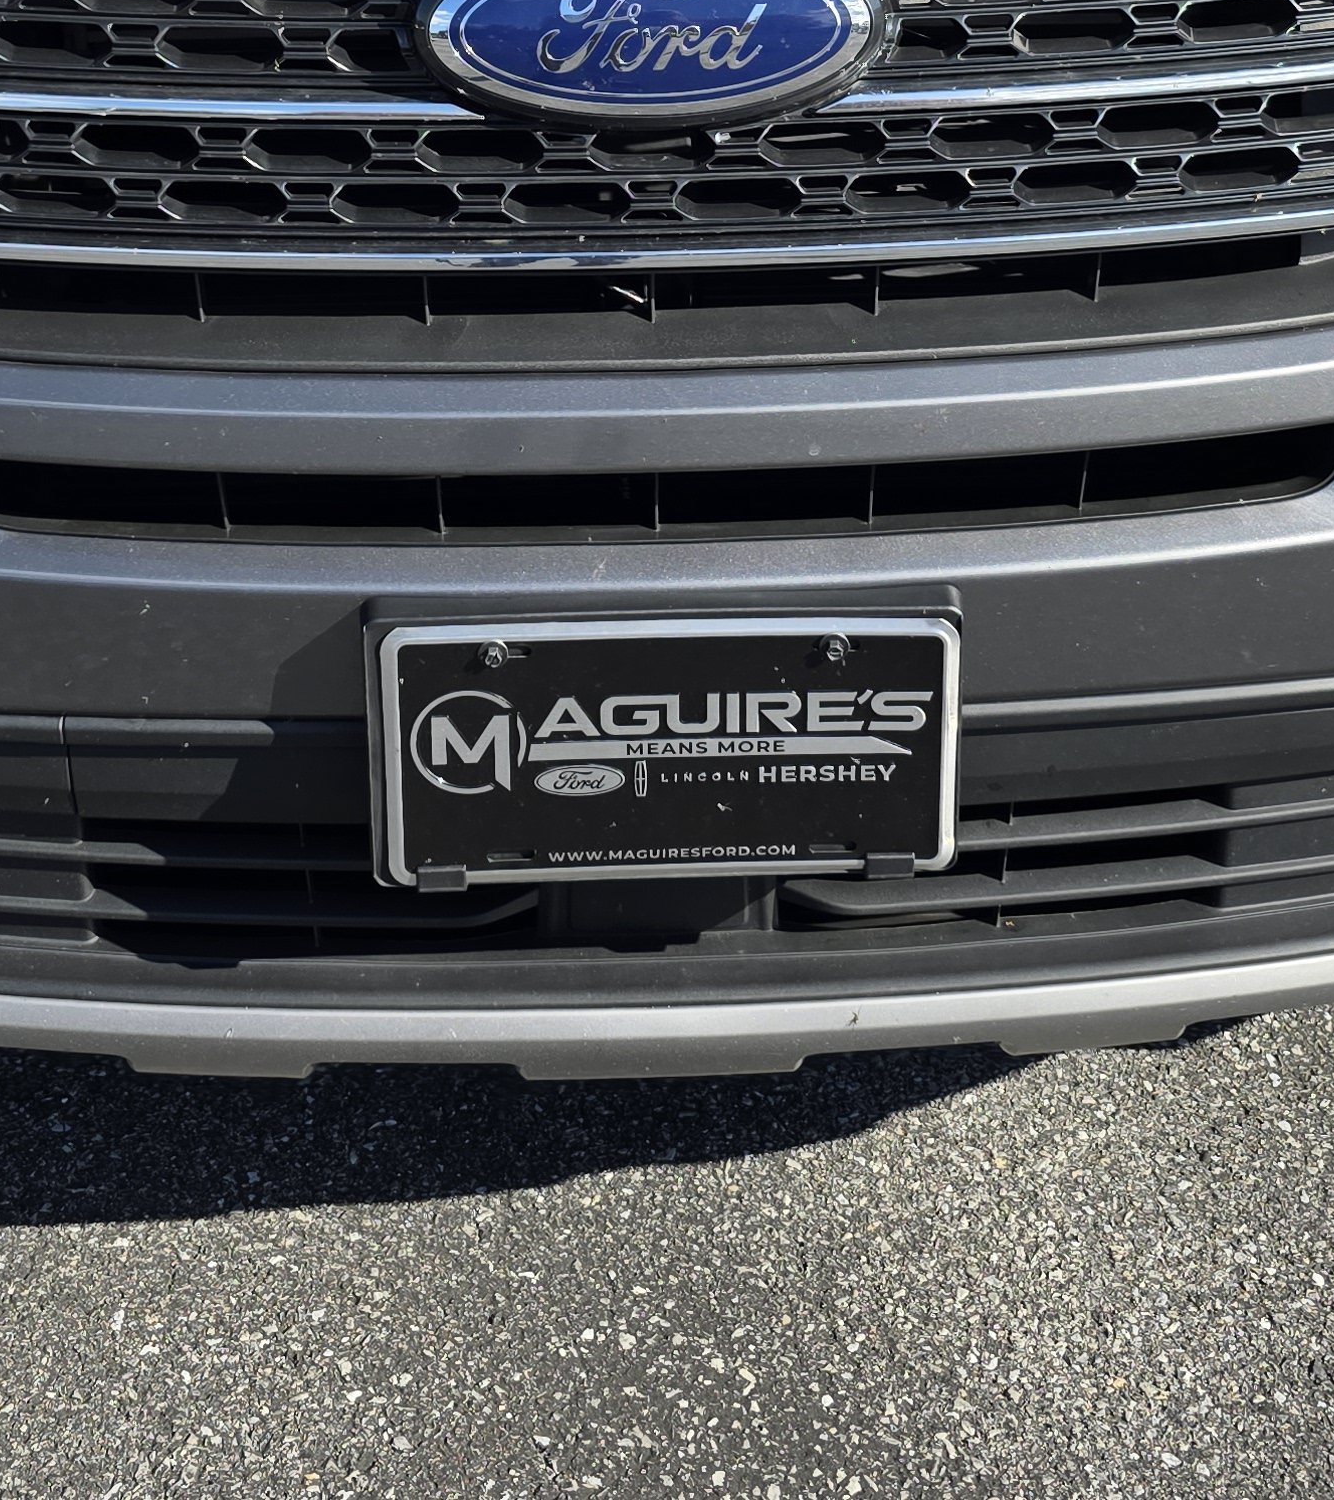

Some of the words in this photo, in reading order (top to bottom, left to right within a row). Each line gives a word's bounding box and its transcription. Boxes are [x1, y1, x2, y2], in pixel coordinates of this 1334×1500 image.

[626, 742, 708, 755] MEANS
[718, 740, 786, 754] MORE
[553, 770, 606, 791] Ford
[660, 770, 749, 783] LINCOLN
[758, 764, 897, 783] HERSHEY
[548, 844, 796, 863] WWW.MAGUIRESFORD.COM
